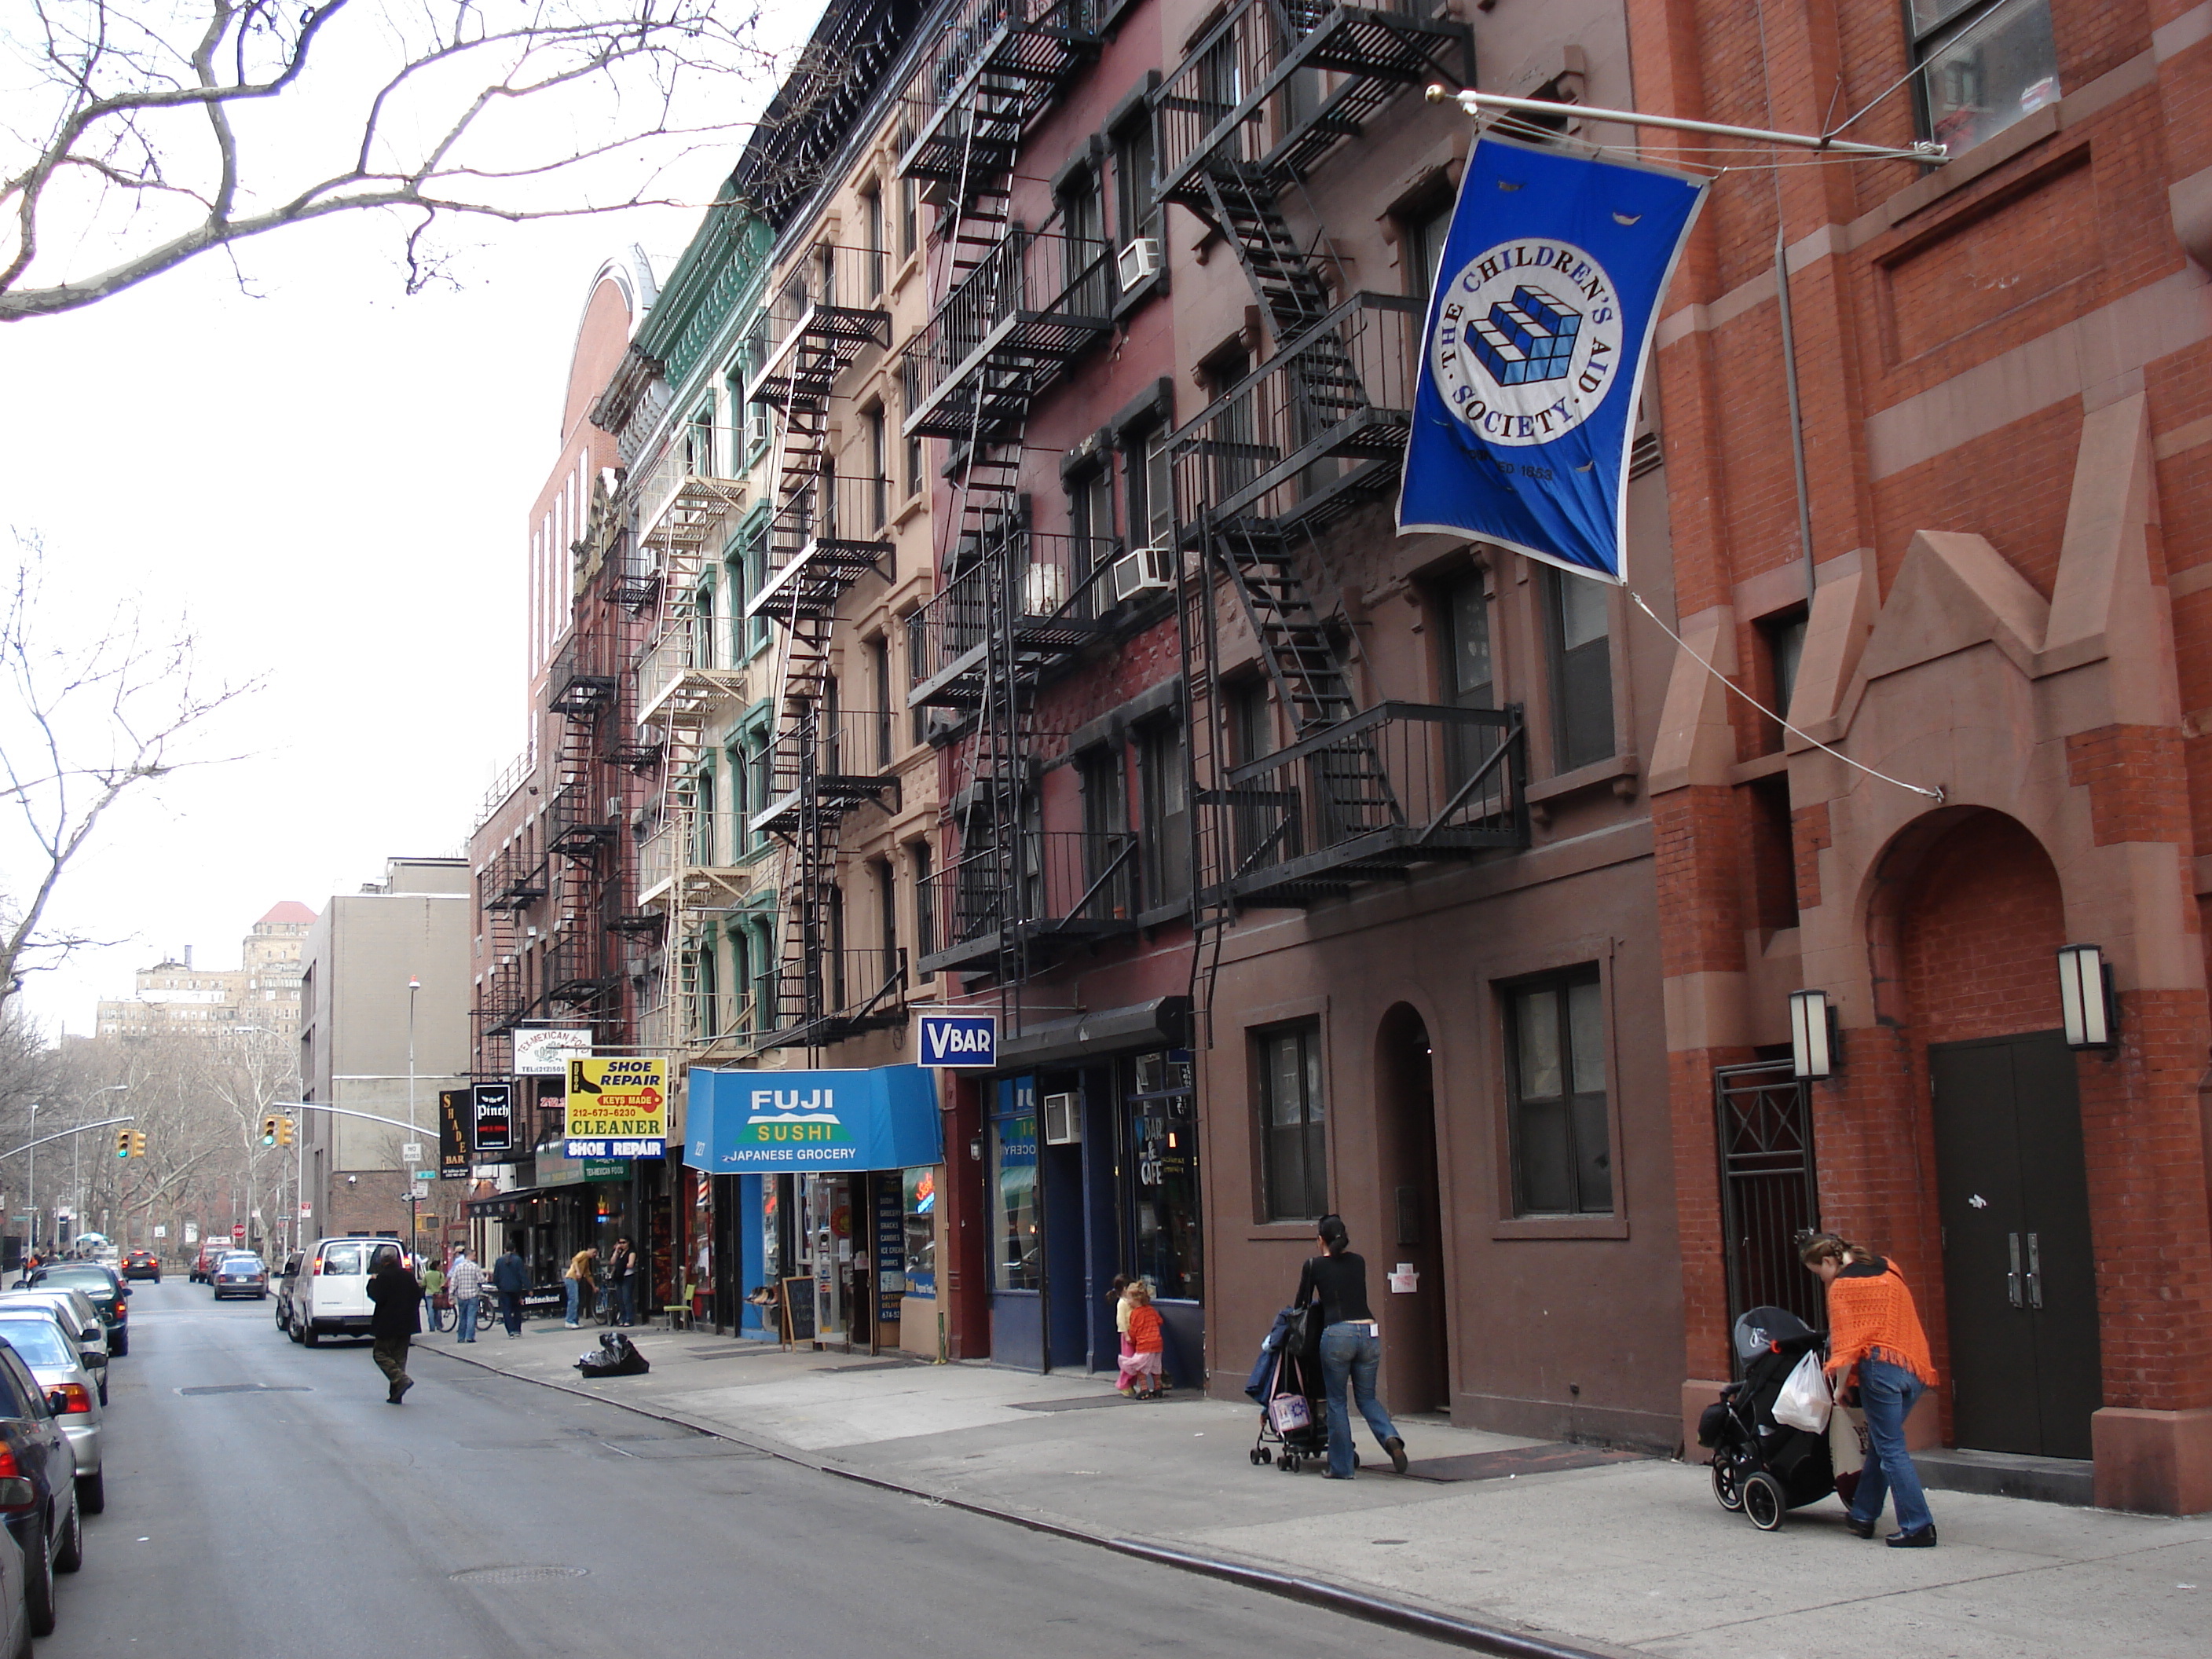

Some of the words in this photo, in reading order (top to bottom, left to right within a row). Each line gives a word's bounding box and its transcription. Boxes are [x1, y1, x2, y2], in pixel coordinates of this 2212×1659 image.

[1441, 302, 1464, 369] THE
[1463, 245, 1613, 324] CHILDREN'S
[1578, 336, 1612, 394] AID
[1452, 384, 1573, 438] SOCIETY
[518, 1031, 570, 1054] TEX-MEXICAN
[607, 1061, 652, 1072] SHOE
[600, 1075, 661, 1086] REPAIR
[602, 1096, 625, 1104] KEYS
[628, 1096, 652, 1104] MADE
[751, 1089, 833, 1110] FUJI
[477, 1104, 508, 1120] Pinch
[443, 1094, 466, 1153] SHADE
[571, 1120, 661, 1135] CLEANER
[758, 1125, 831, 1141] SUSHI
[568, 1141, 606, 1156] SHOE
[613, 1141, 661, 1156] REPAIR
[731, 1149, 793, 1162] JAPANESE
[797, 1148, 856, 1159] GROCERY
[445, 1155, 465, 1164] BAR
[1141, 1160, 1163, 1186] CAFE
[525, 1295, 560, 1305] Heineken
